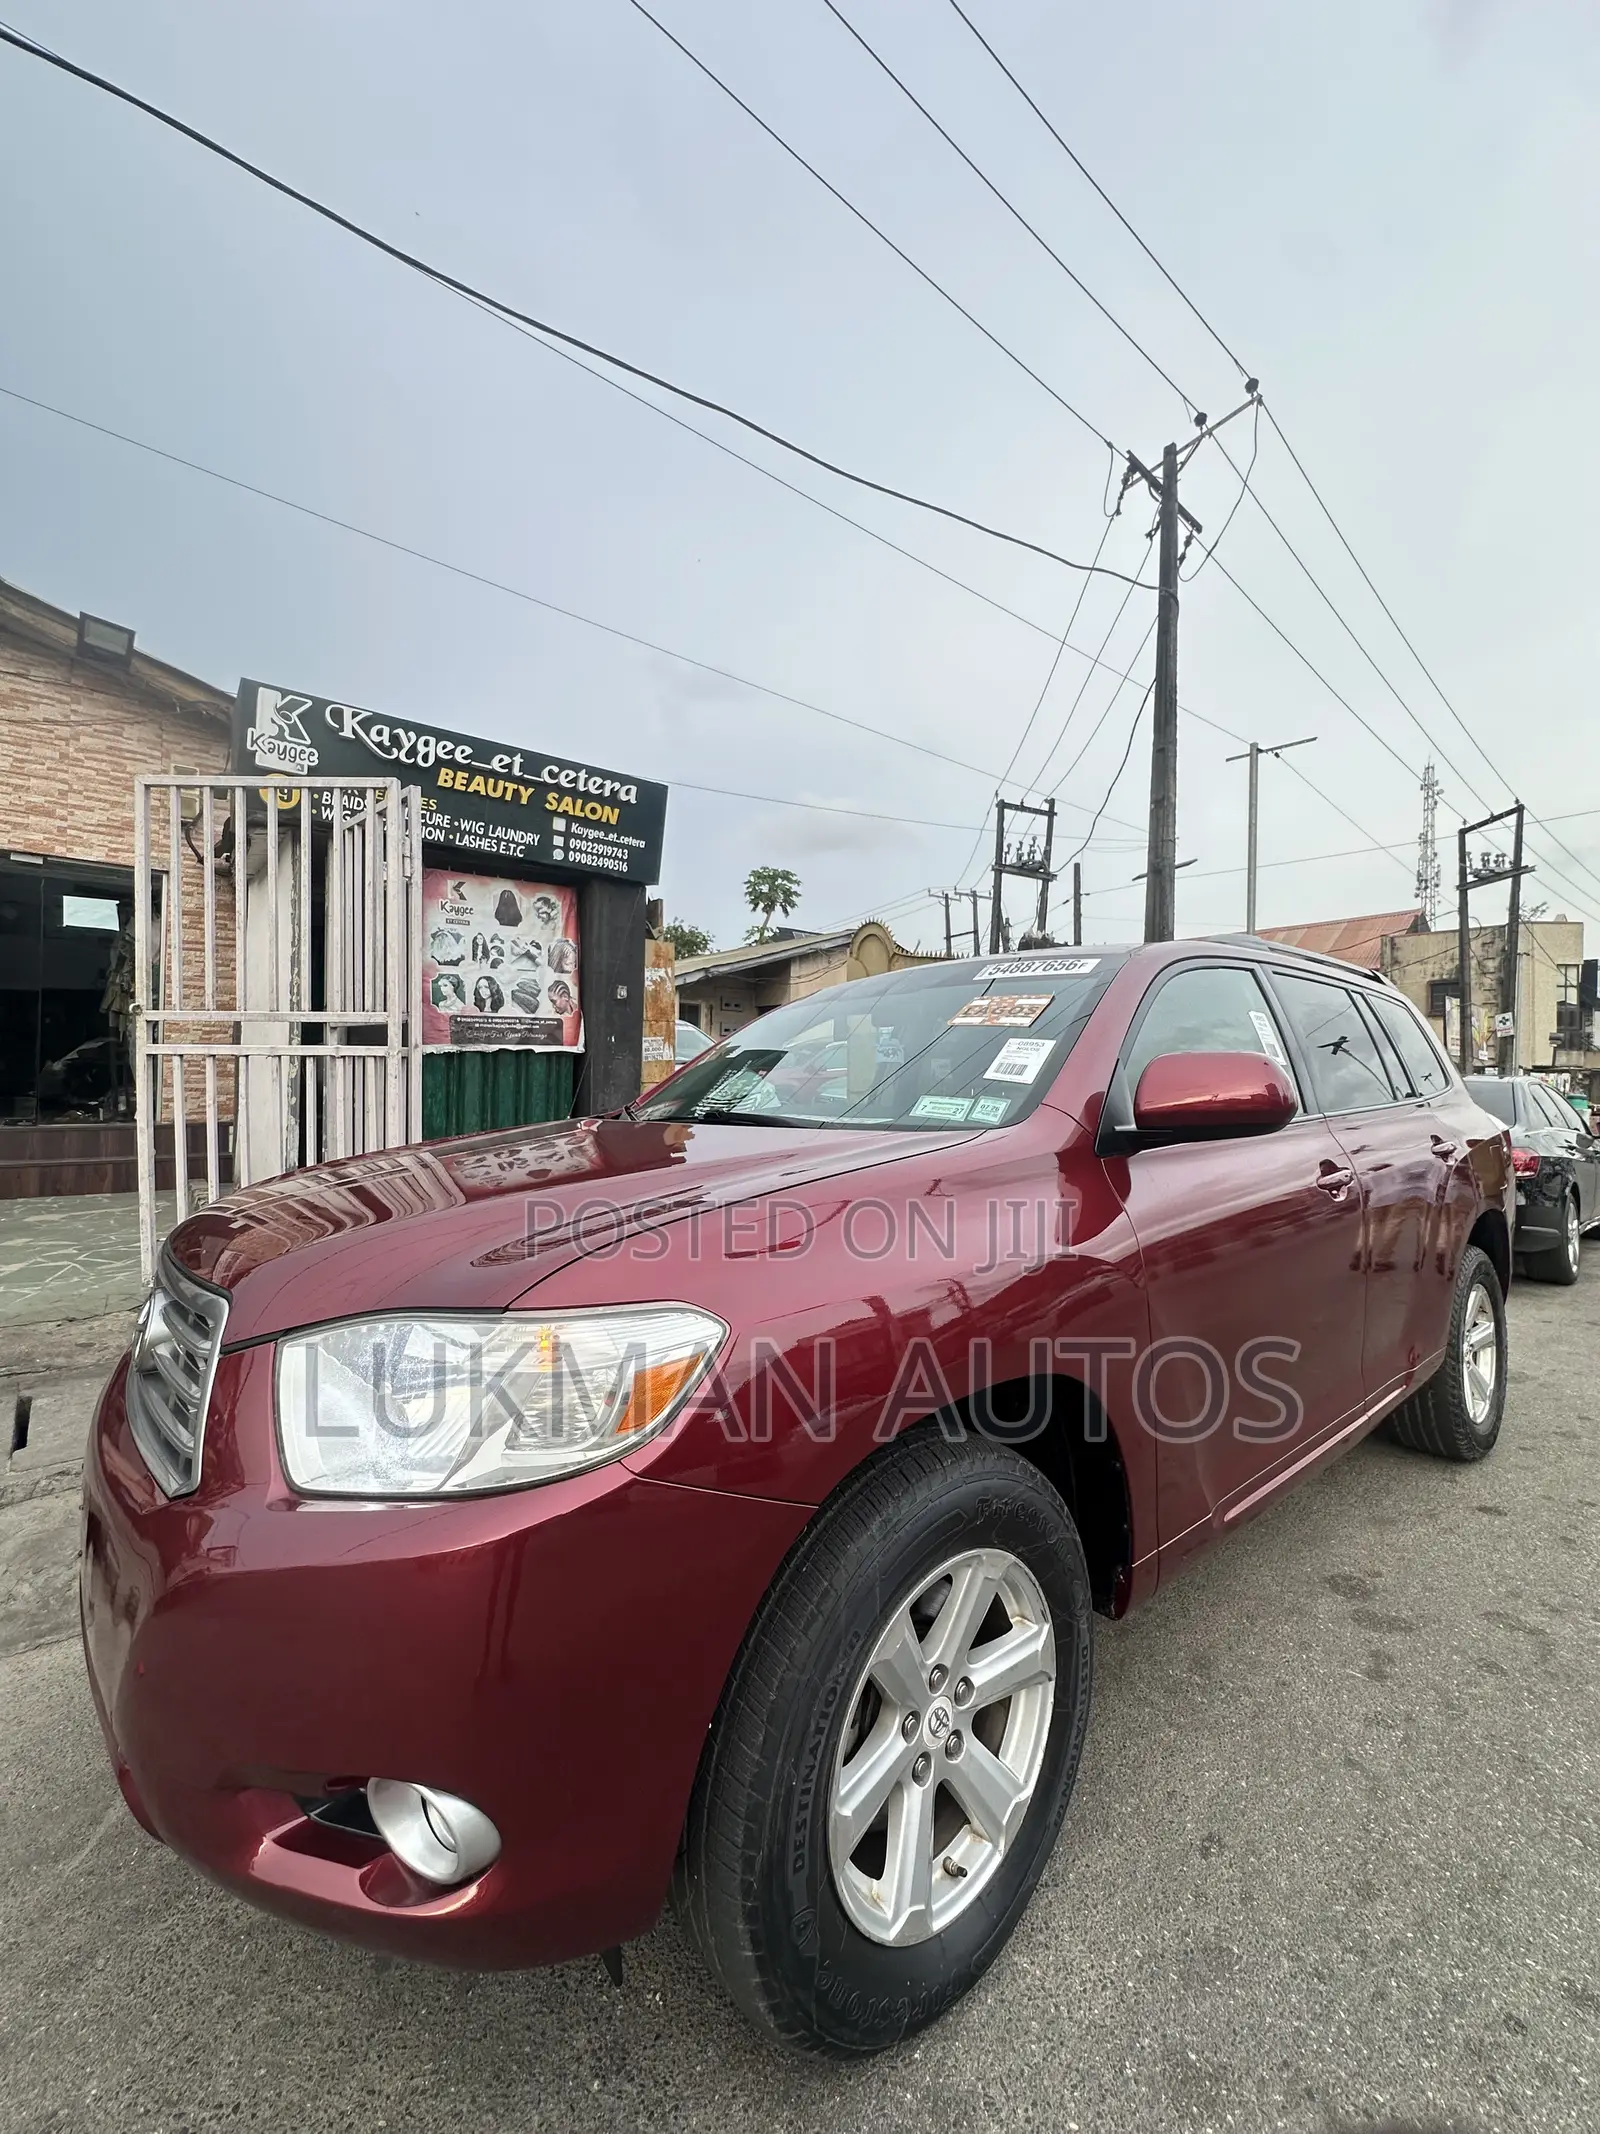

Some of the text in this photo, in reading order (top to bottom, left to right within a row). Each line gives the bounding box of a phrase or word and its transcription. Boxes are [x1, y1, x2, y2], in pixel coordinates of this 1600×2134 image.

[248, 728, 319, 766] Kaygee
[321, 790, 370, 812] BAID
[437, 767, 535, 805] BEAUTY
[544, 791, 621, 825] SALON
[460, 818, 485, 835] WIG
[488, 824, 540, 847] LAUNDRY
[455, 832, 525, 858] LASHES E.T.C
[569, 838, 629, 860] 09022919743
[568, 850, 628, 873] 09082490516
[440, 900, 475, 917] Kaygee
[962, 1004, 1040, 1016] LAGOS
[952, 1107, 965, 1115] 27
[974, 1492, 1076, 1577] Firestone
